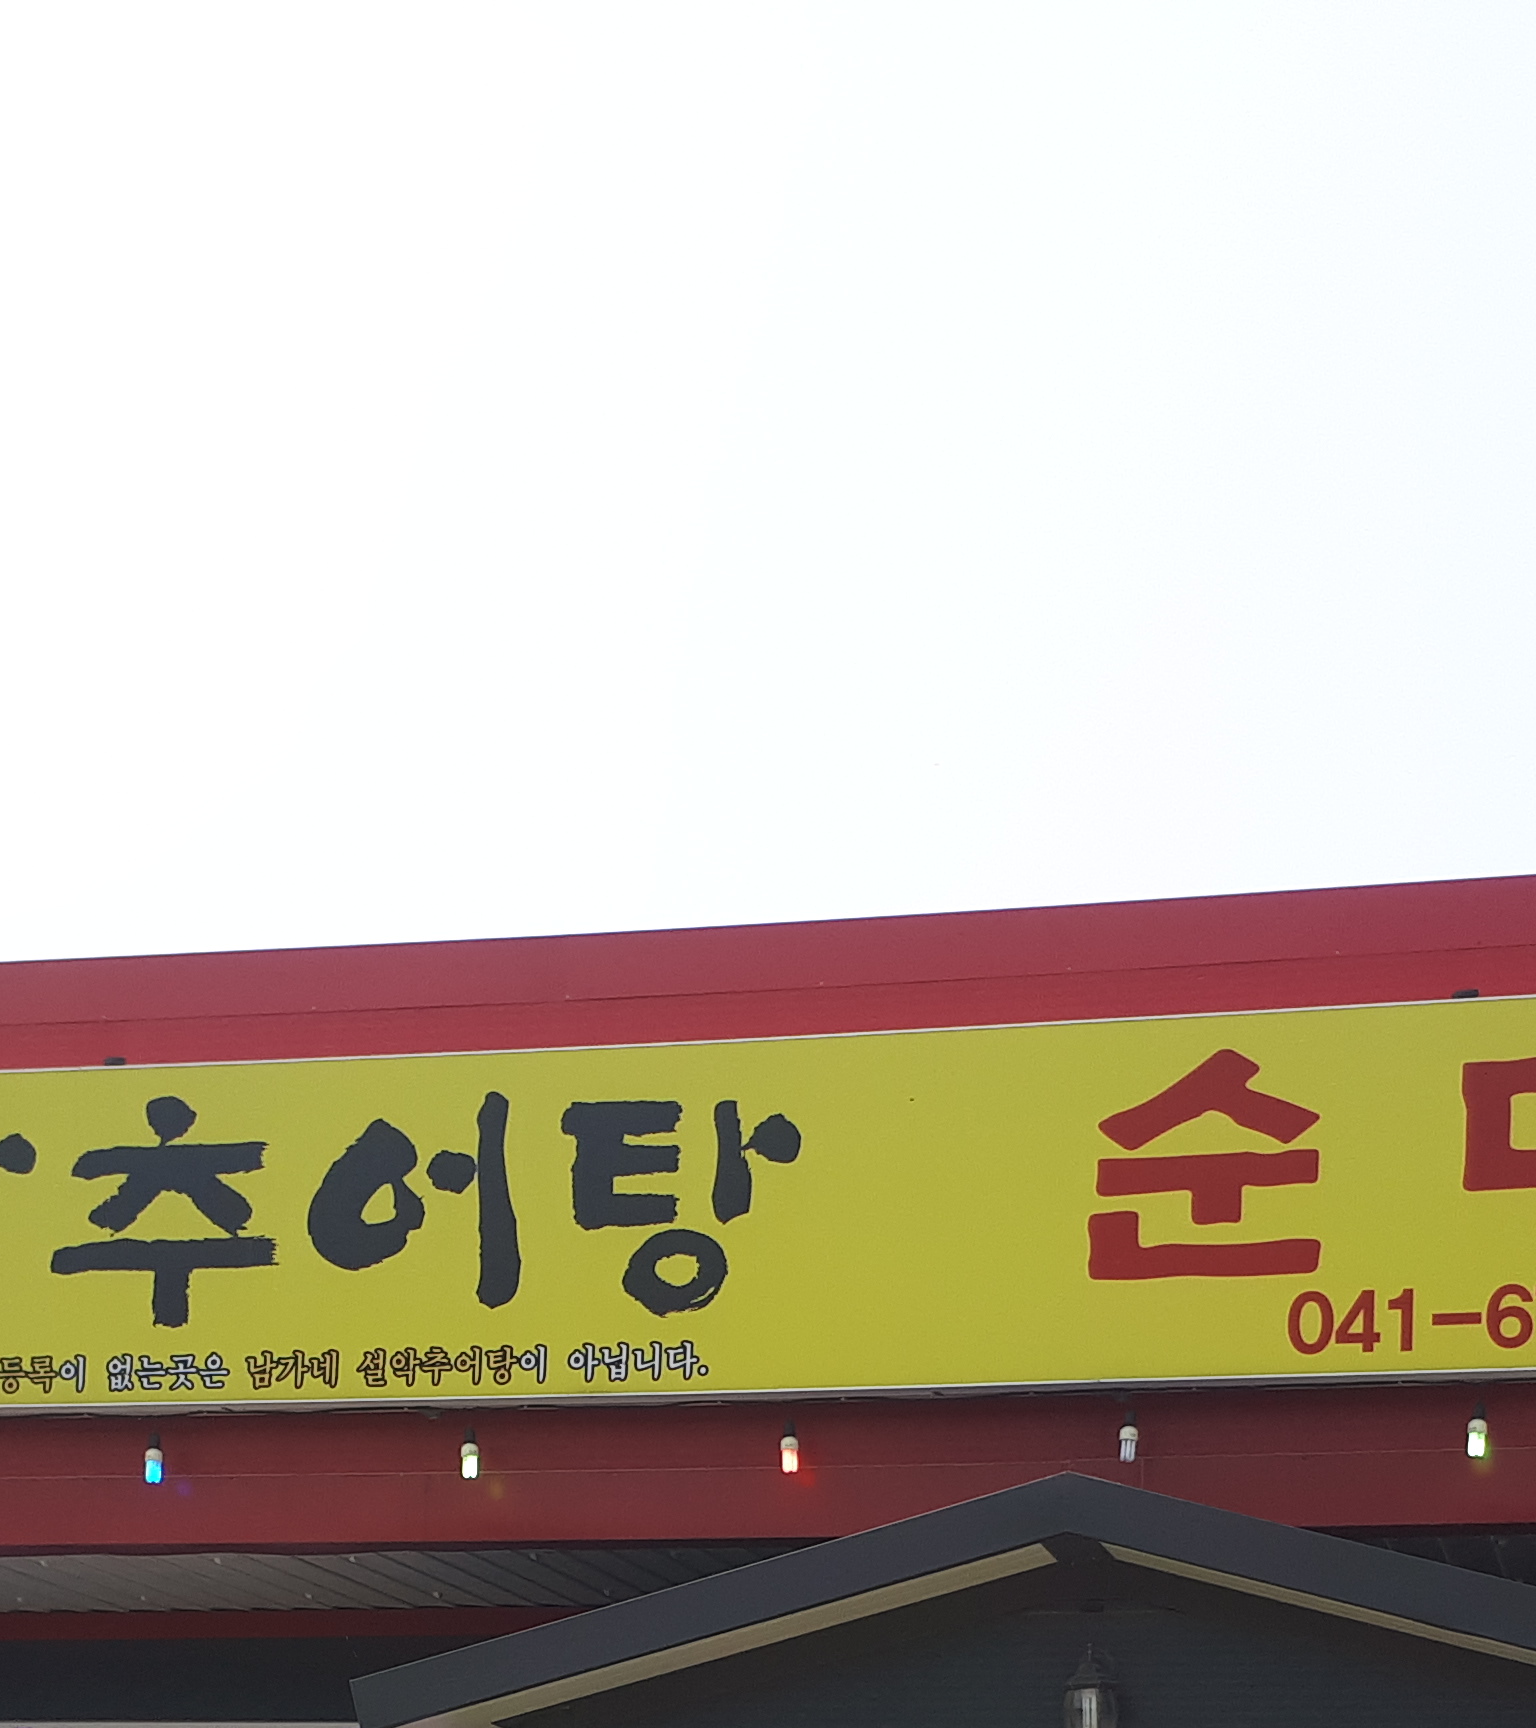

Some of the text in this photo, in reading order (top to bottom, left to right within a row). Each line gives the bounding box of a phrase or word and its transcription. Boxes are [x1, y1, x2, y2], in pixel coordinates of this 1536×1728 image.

[105, 1351, 231, 1393] 없는곳은
[244, 1348, 340, 1391] 남가네
[355, 1343, 548, 1388] 설악추어탕이
[567, 1339, 710, 1384] 아닙니다.
